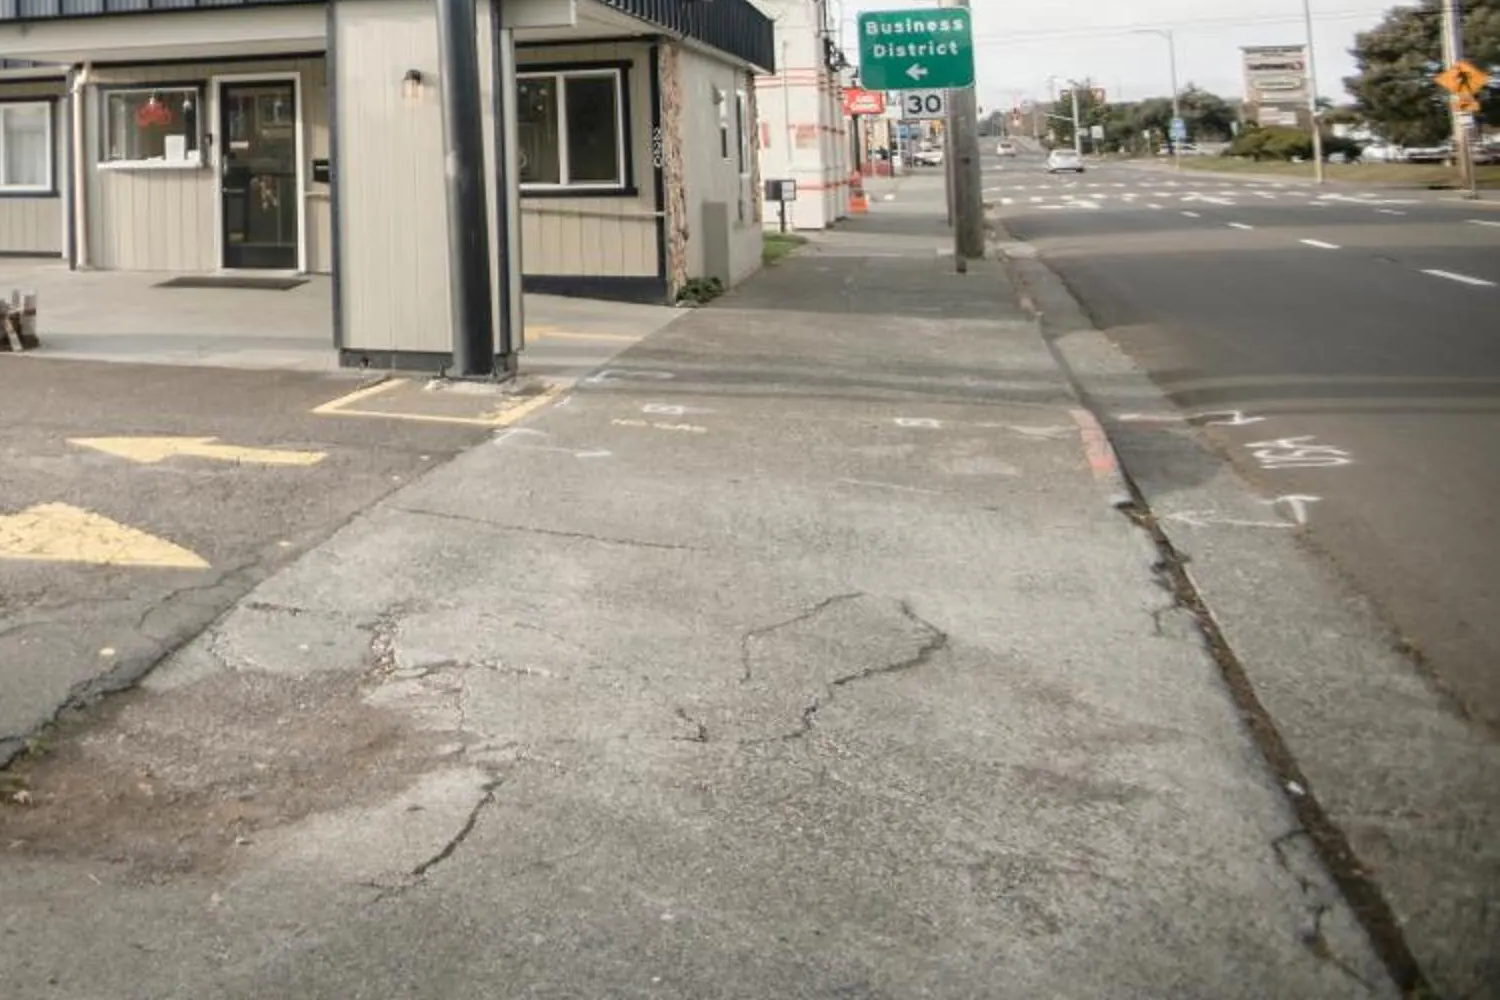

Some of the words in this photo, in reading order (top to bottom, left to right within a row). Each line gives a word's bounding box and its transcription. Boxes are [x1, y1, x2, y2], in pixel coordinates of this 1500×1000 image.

[865, 18, 964, 35] Business
[873, 41, 958, 58] District
[907, 94, 942, 114] 30
